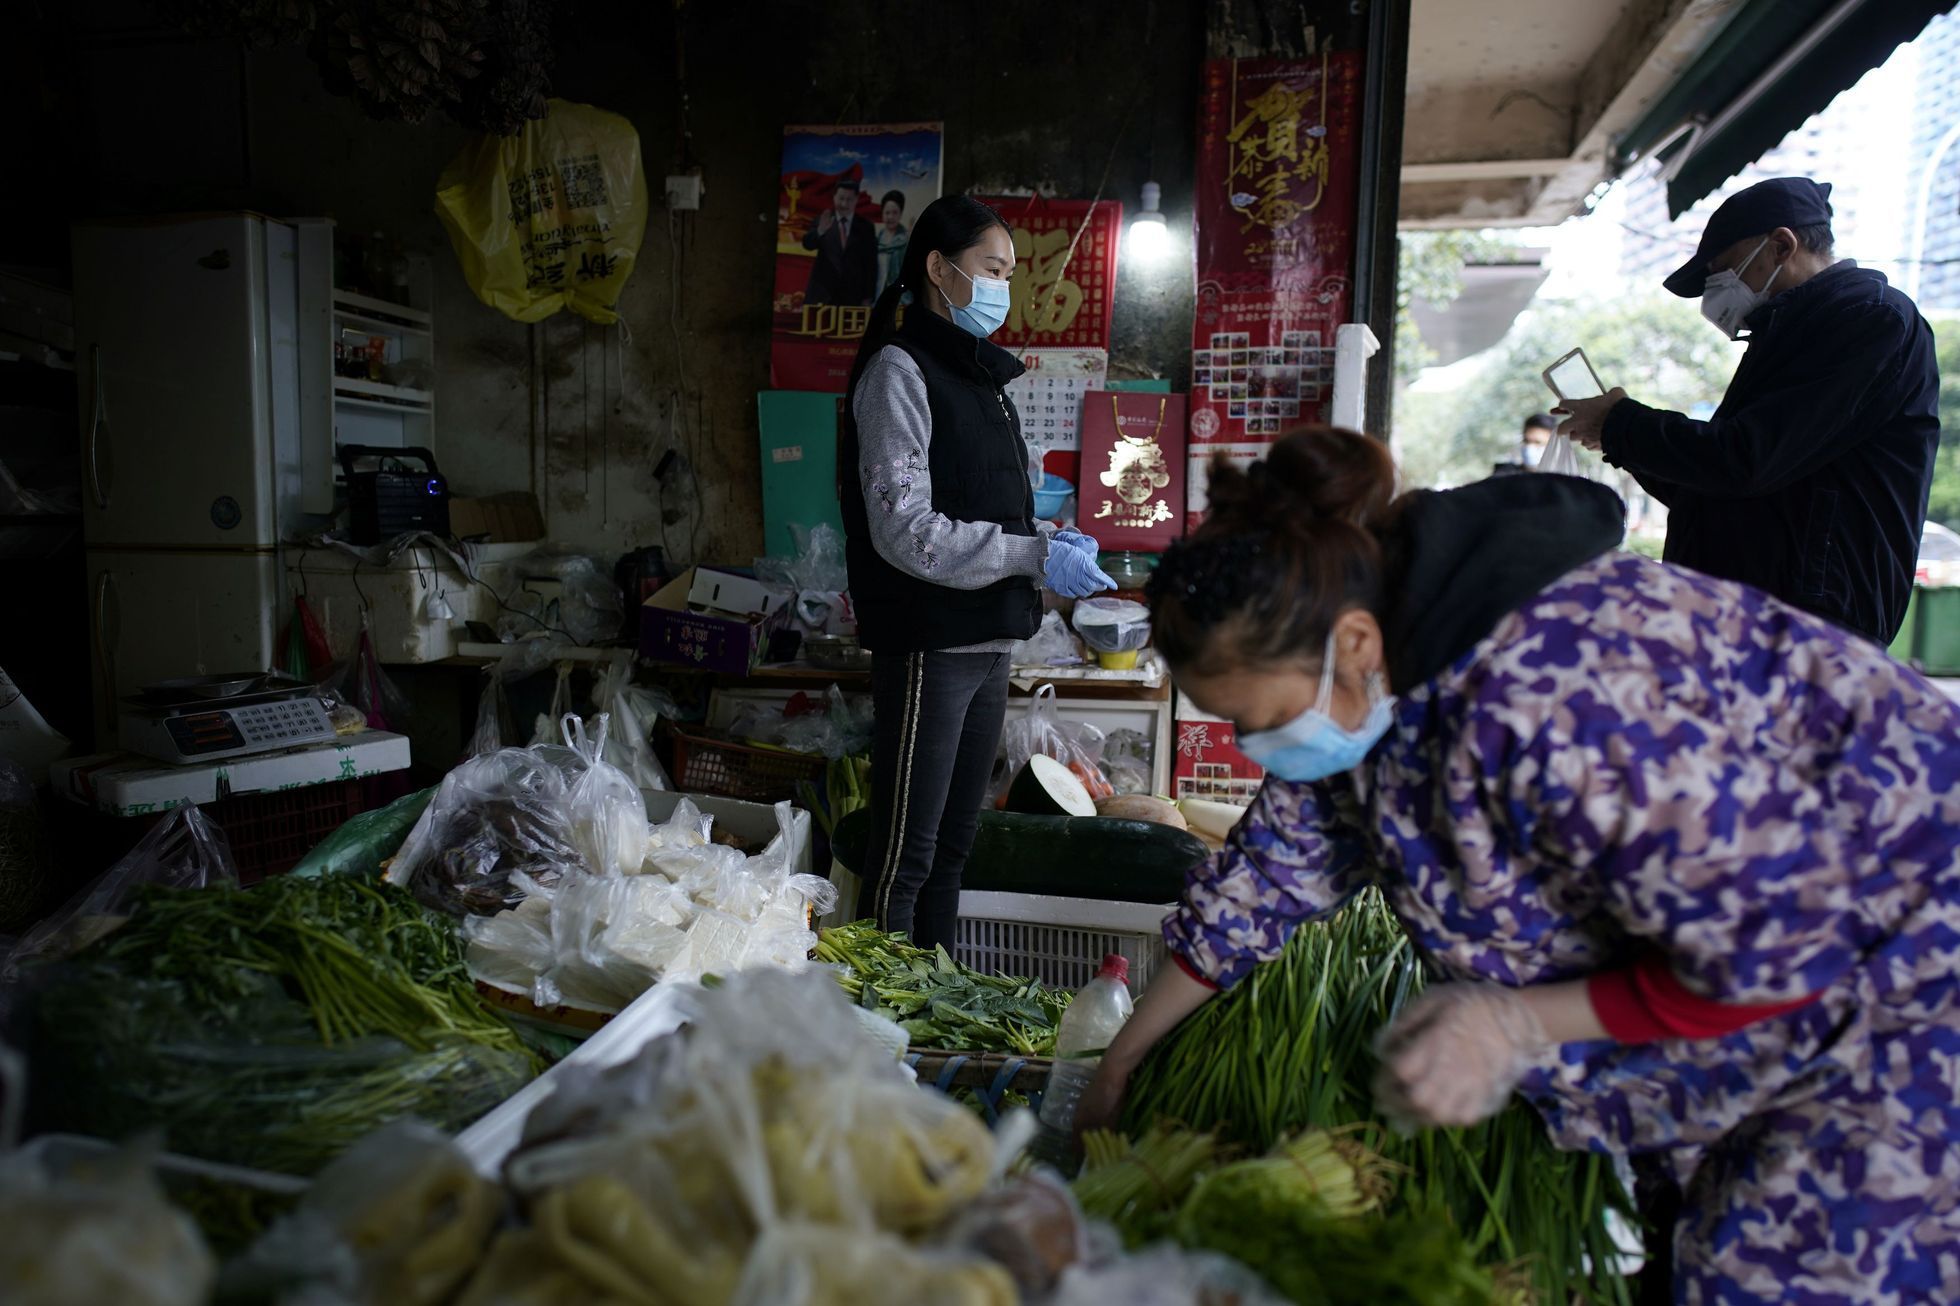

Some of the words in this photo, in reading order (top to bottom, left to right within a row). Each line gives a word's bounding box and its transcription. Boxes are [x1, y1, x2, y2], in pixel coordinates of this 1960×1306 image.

[1008, 227, 1084, 334] 福
[1025, 355, 1039, 370] 01
[1029, 379, 1034, 388] 1
[1048, 379, 1054, 388] 2
[1068, 379, 1074, 388] 3
[1028, 392, 1034, 401] 8
[1047, 392, 1053, 401] 9
[1066, 393, 1076, 401] 10
[1026, 406, 1036, 414] 15
[1045, 406, 1055, 414] 16
[1025, 419, 1036, 427] 22
[1044, 419, 1055, 428] 23
[1063, 419, 1075, 428] 24
[1024, 432, 1035, 441] 29
[1043, 432, 1055, 441] 30
[1063, 433, 1074, 441] 31
[1176, 724, 1214, 762] 祥
